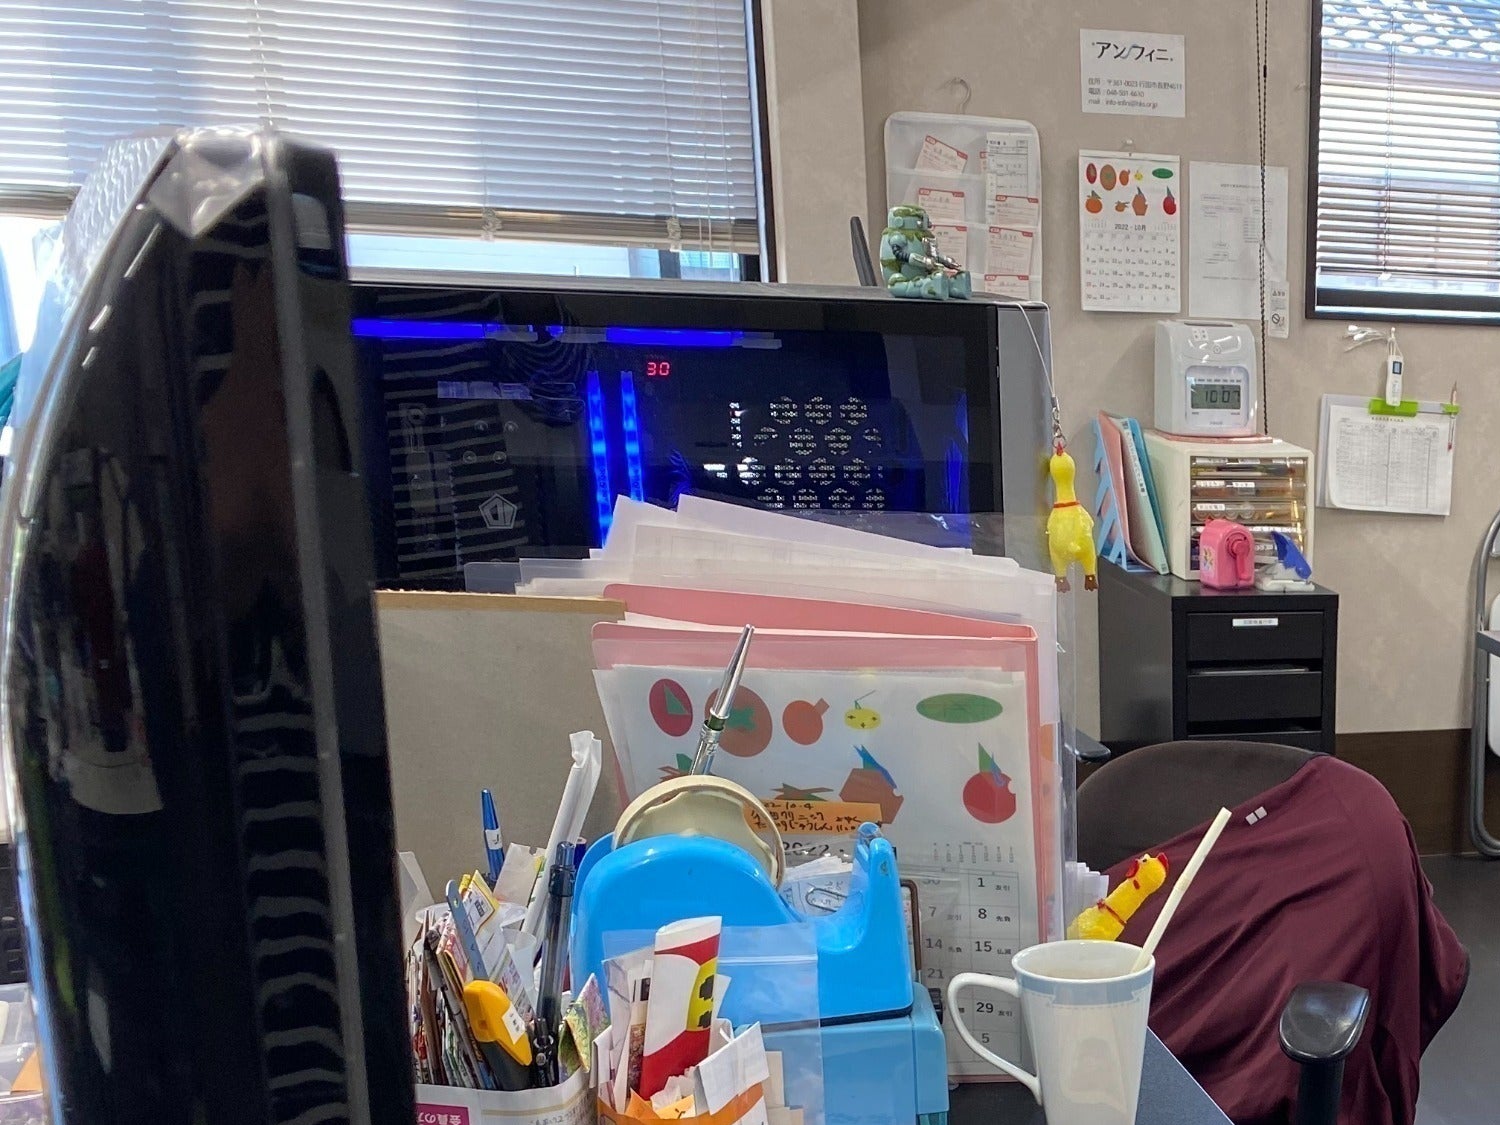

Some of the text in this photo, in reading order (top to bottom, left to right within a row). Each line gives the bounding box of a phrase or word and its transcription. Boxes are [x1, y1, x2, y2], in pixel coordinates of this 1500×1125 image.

[646, 361, 671, 377] 30
[977, 877, 986, 888] 1
[978, 908, 987, 920] 8
[925, 938, 943, 950] 14
[975, 941, 992, 953] 15
[976, 1001, 994, 1014] 29
[981, 1032, 990, 1044] 5
